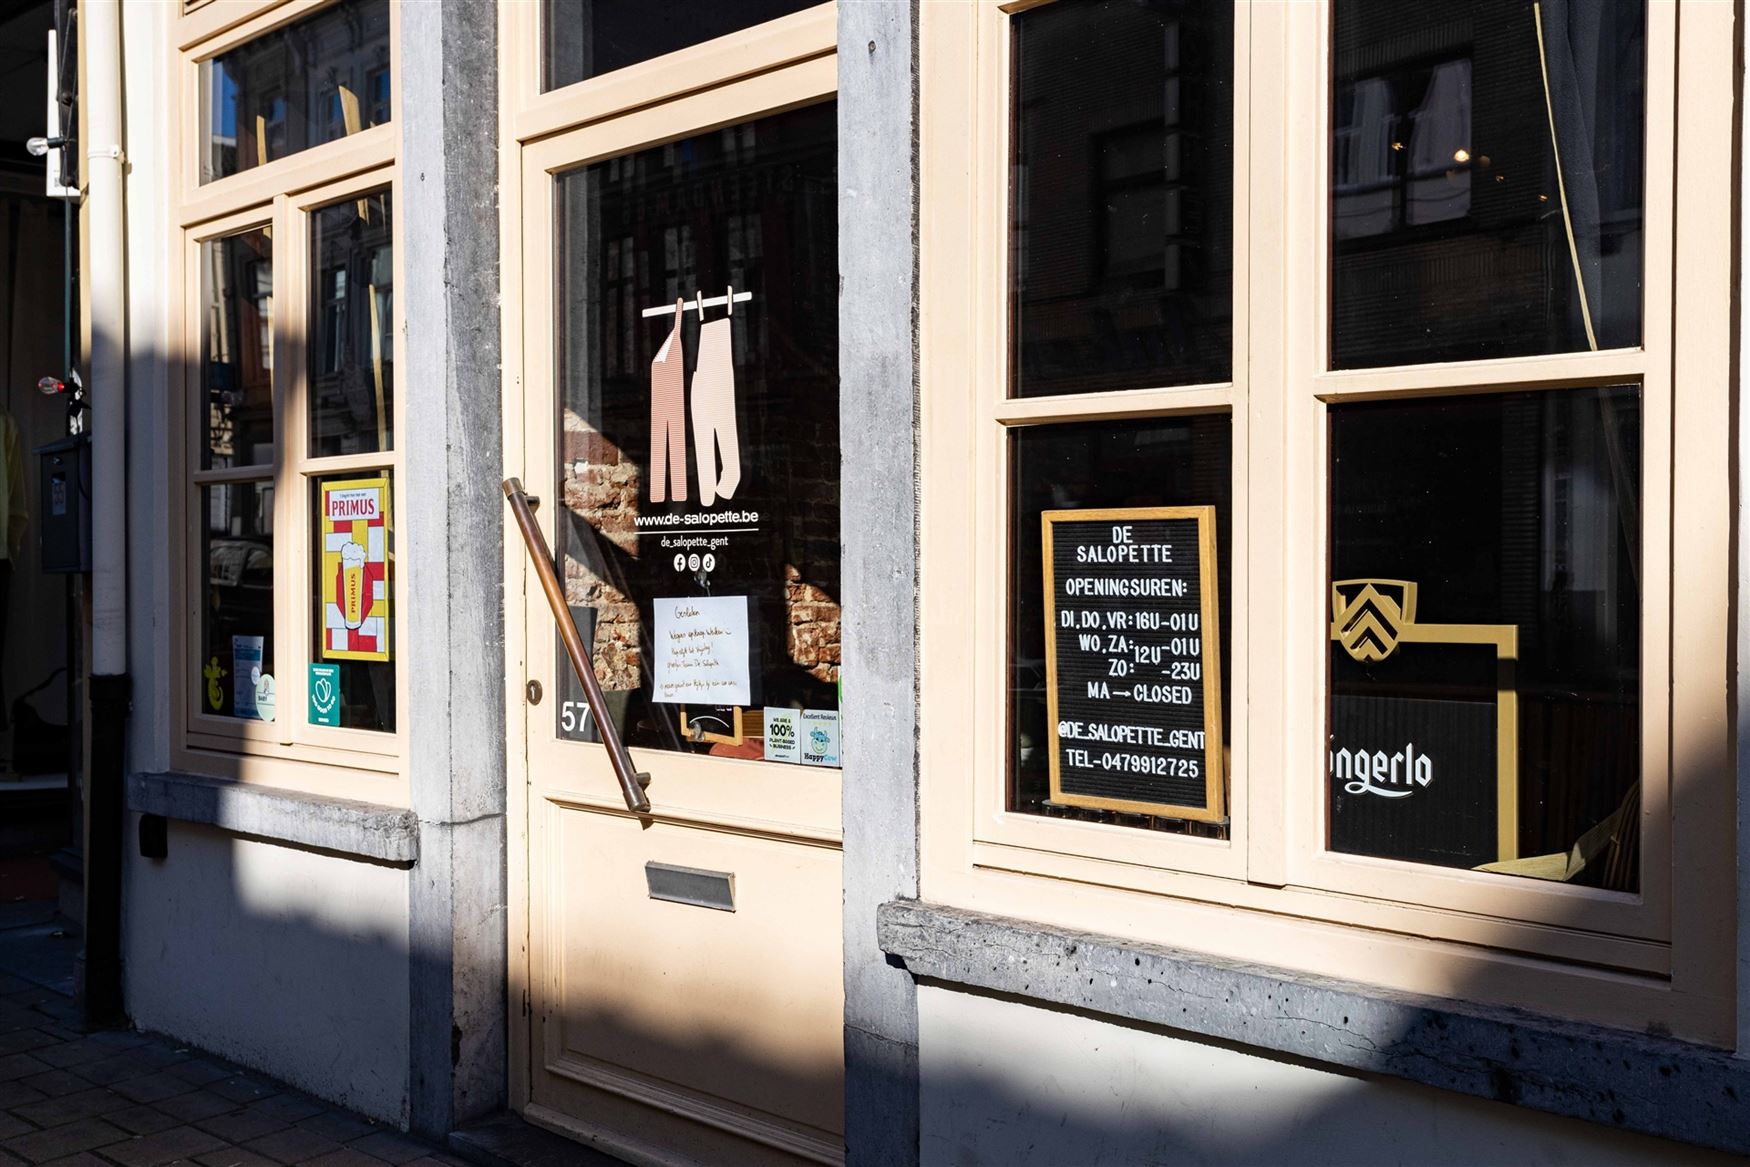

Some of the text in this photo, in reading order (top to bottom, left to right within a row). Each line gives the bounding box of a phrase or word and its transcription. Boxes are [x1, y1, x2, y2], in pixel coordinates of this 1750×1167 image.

[332, 498, 375, 516] PRIMUS
[634, 510, 759, 526] www.de-salopette.be
[660, 535, 729, 551] de_salopette_gent
[1112, 526, 1133, 543] DE
[1077, 544, 1172, 563] SALOPETTE
[1065, 578, 1188, 597] OPENINGSUREN:
[1108, 658, 1135, 677] ZO:
[1087, 681, 1193, 704] MA CLOSED
[561, 701, 591, 732] 57
[770, 723, 795, 738] 100%
[1058, 720, 1205, 750] @DE_SALOPETTE_GENT
[1065, 749, 1199, 778] TEL-0479912725
